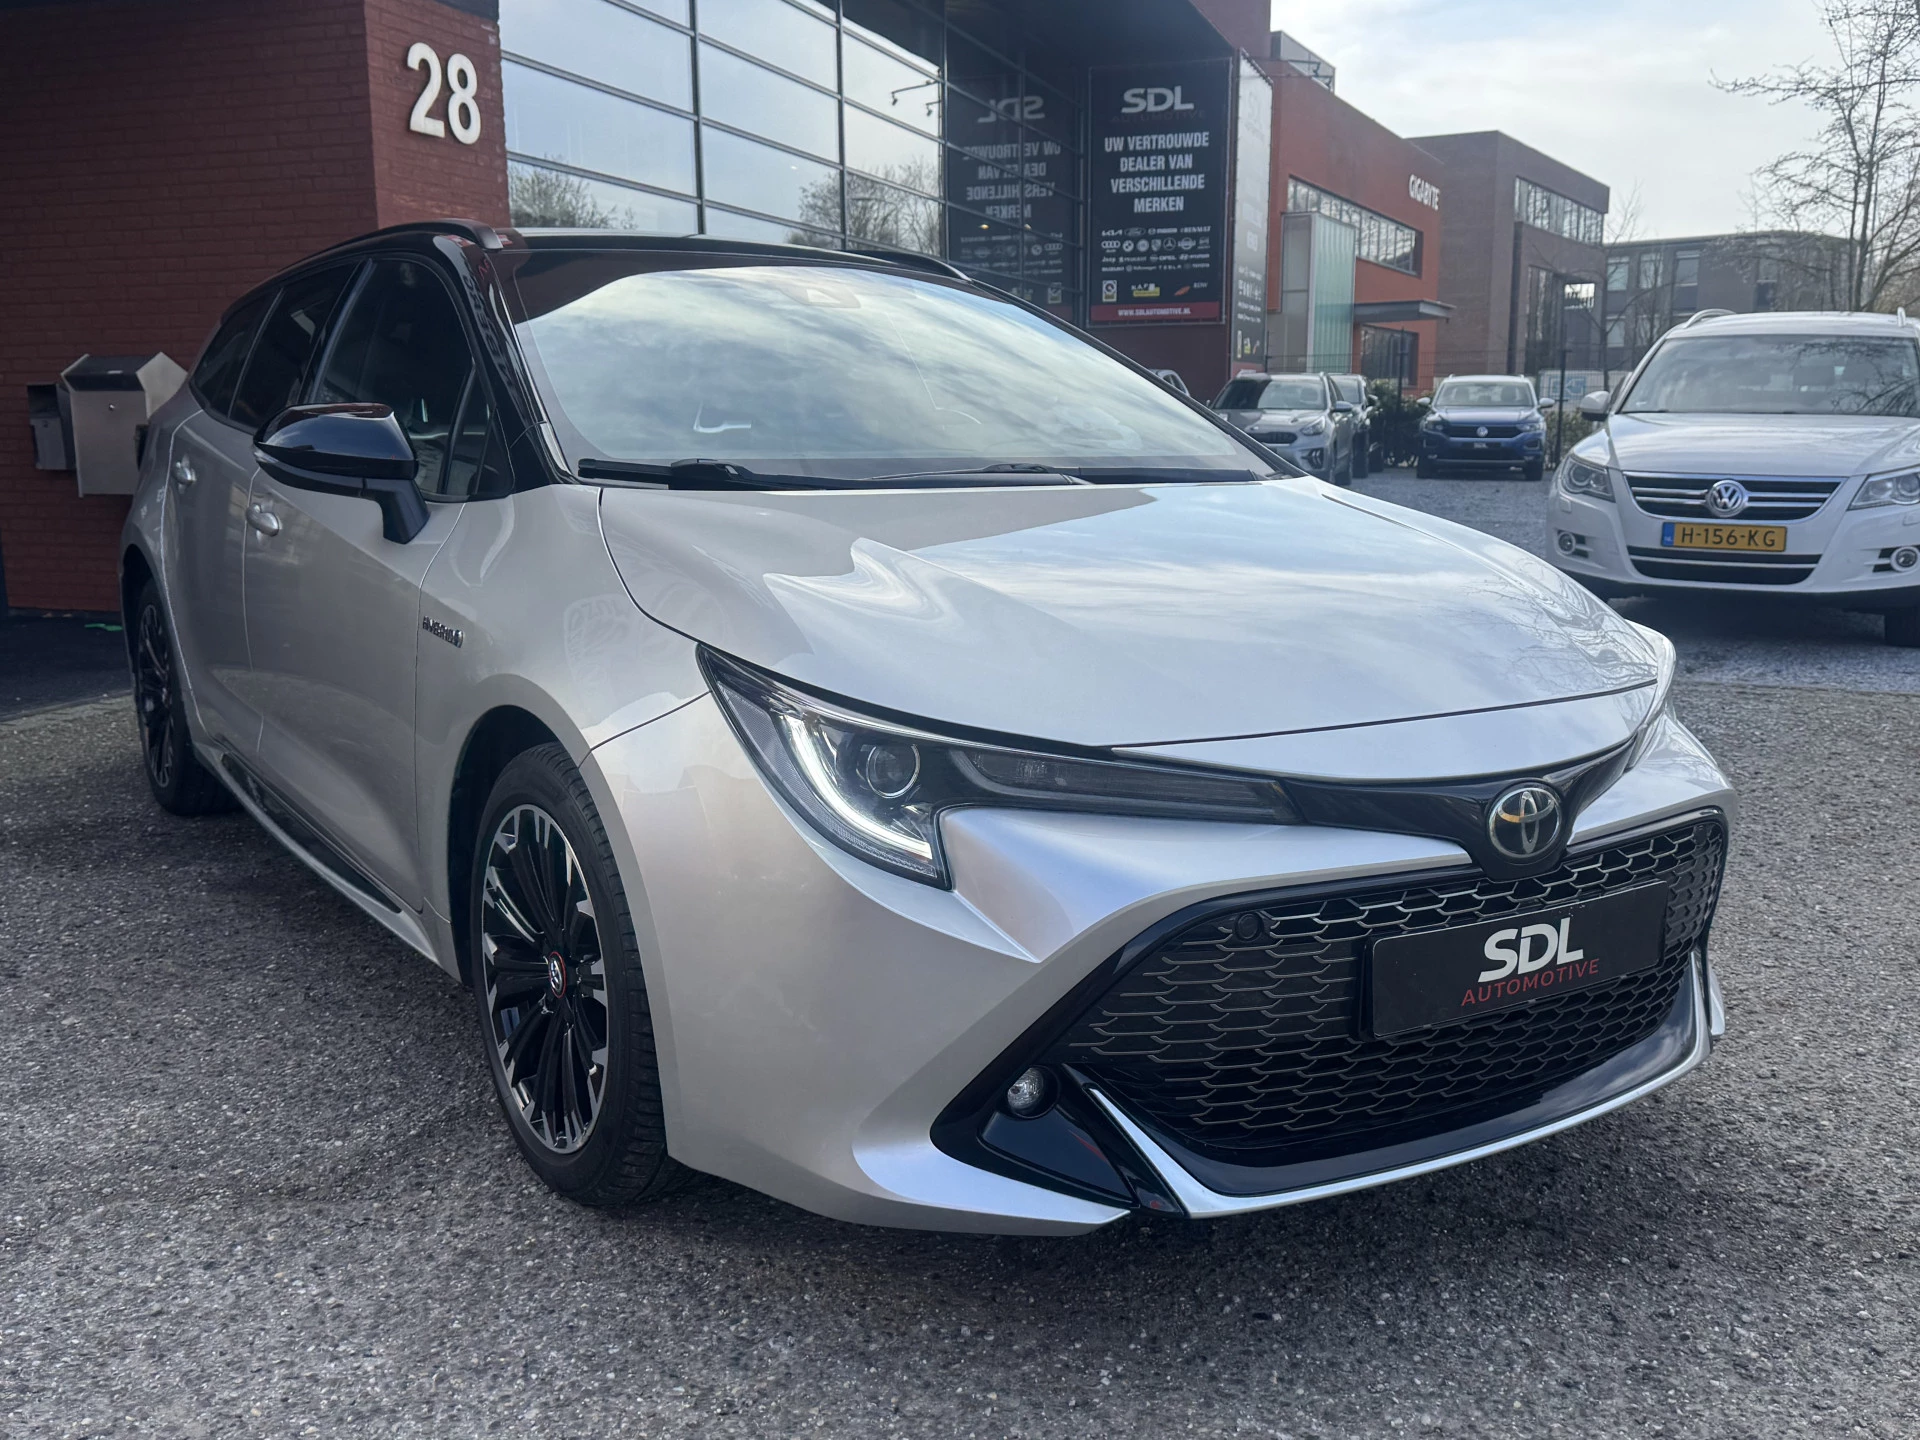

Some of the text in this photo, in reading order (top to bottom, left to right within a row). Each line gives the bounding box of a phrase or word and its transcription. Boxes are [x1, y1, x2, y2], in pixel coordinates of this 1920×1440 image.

[407, 42, 481, 145] 28
[1121, 86, 1195, 114] SDL
[1104, 132, 1209, 152] UW VERTROUWDE
[1120, 153, 1193, 172] DEALER VAN
[1110, 174, 1205, 193] VERSCHILLENDE
[1133, 196, 1184, 213] MERKEN
[1680, 526, 1776, 548] H-156-KG
[1478, 917, 1584, 982] SDL
[1461, 958, 1600, 1006] AUTOMOTIVE
